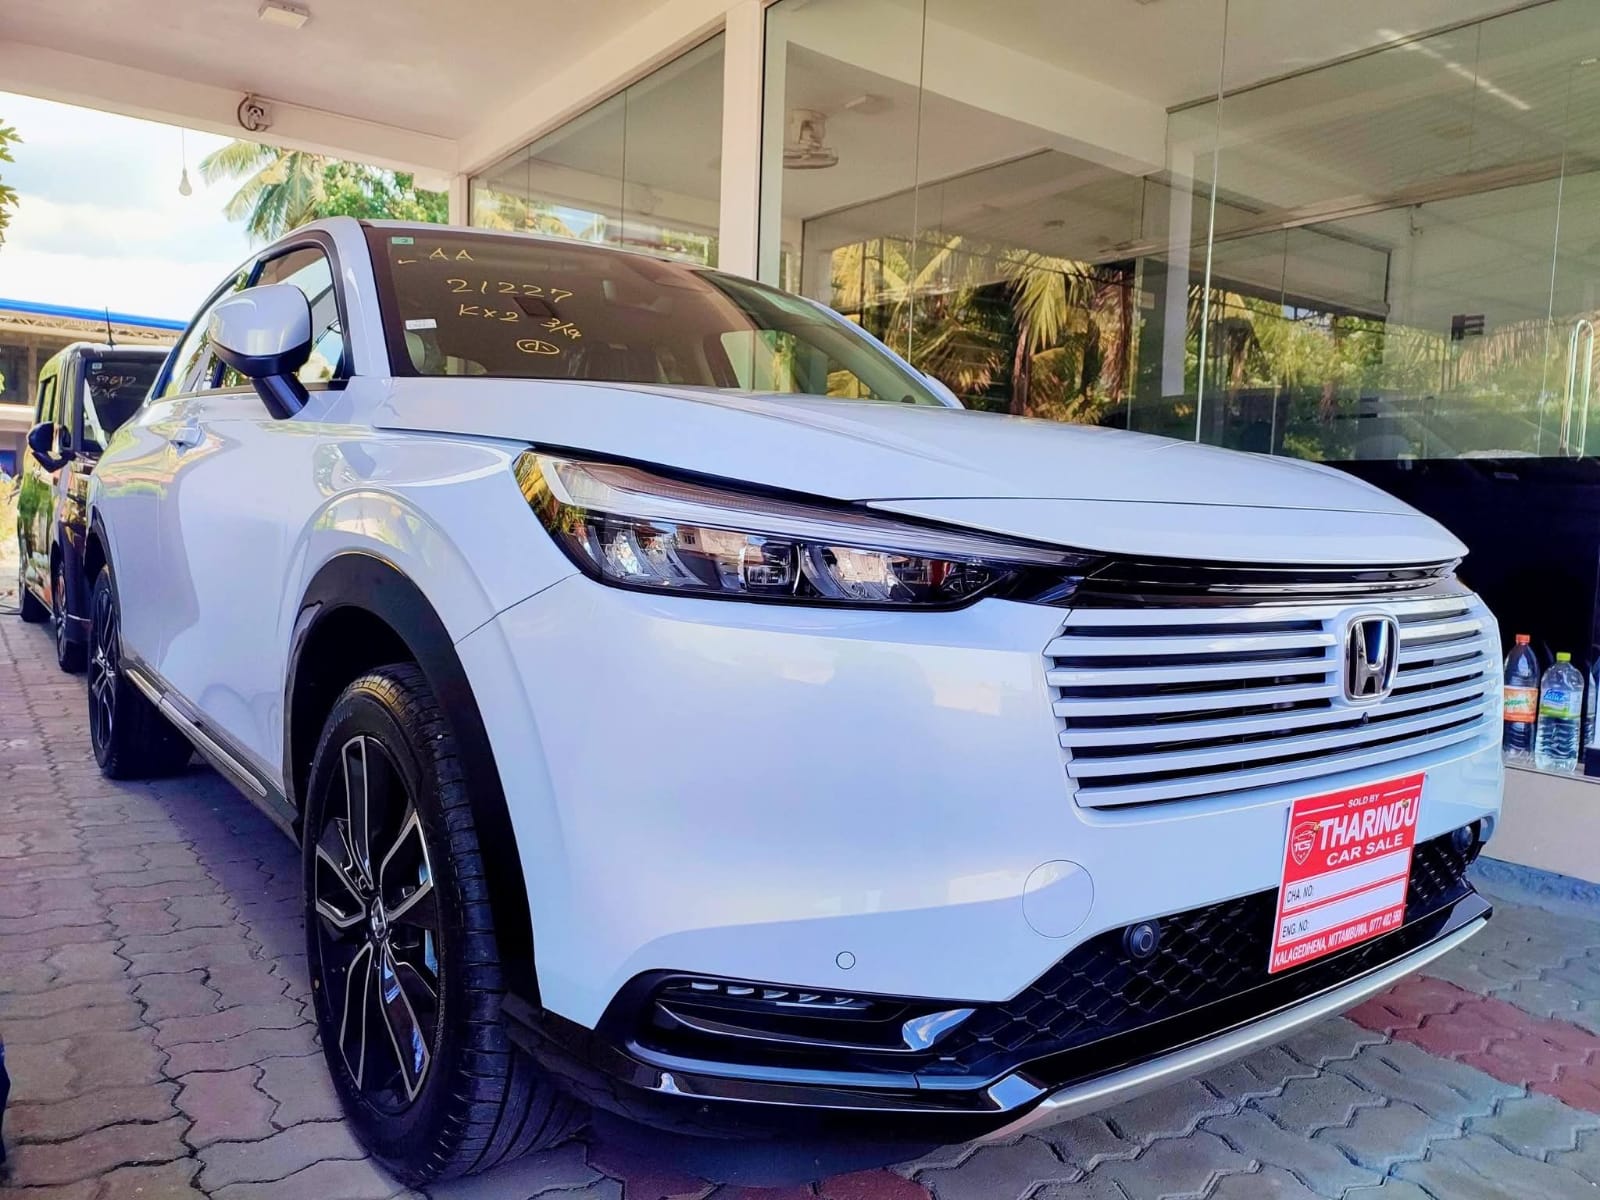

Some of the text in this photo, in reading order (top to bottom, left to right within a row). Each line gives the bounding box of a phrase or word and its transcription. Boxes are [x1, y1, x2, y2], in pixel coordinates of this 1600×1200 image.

[447, 279, 573, 303] 21227
[1347, 794, 1380, 808] SOLD BY
[1319, 796, 1419, 850] THARINDU
[1326, 833, 1404, 866] CAR SALE
